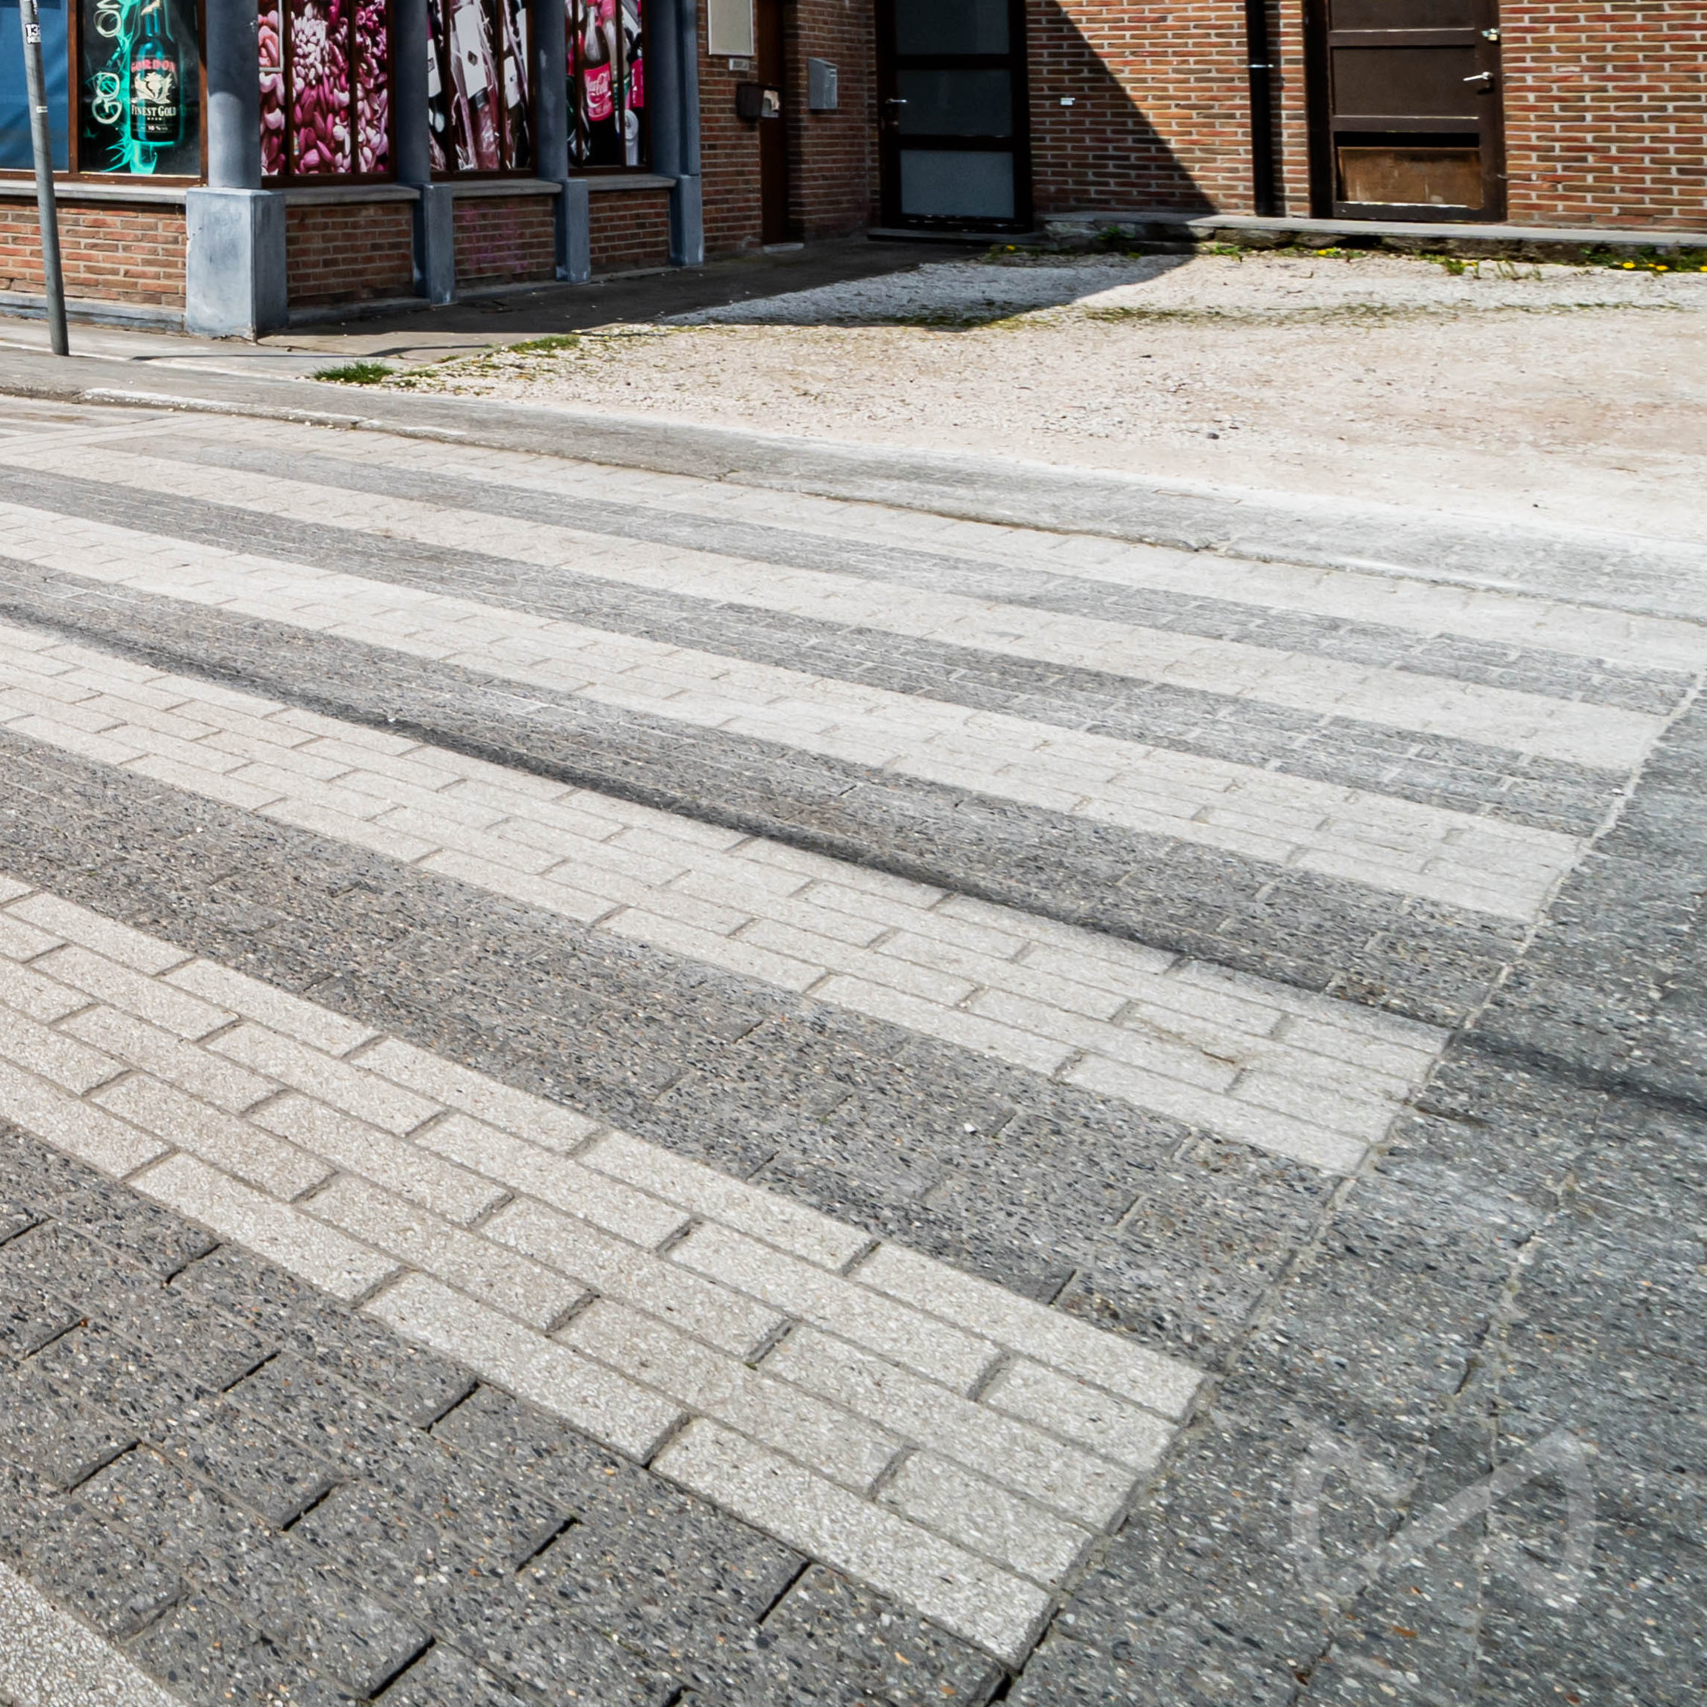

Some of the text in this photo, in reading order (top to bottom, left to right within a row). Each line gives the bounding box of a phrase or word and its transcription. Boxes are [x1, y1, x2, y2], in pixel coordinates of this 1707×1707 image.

[131, 59, 176, 73] GORDON
[131, 104, 177, 117] FINEST GOLD
